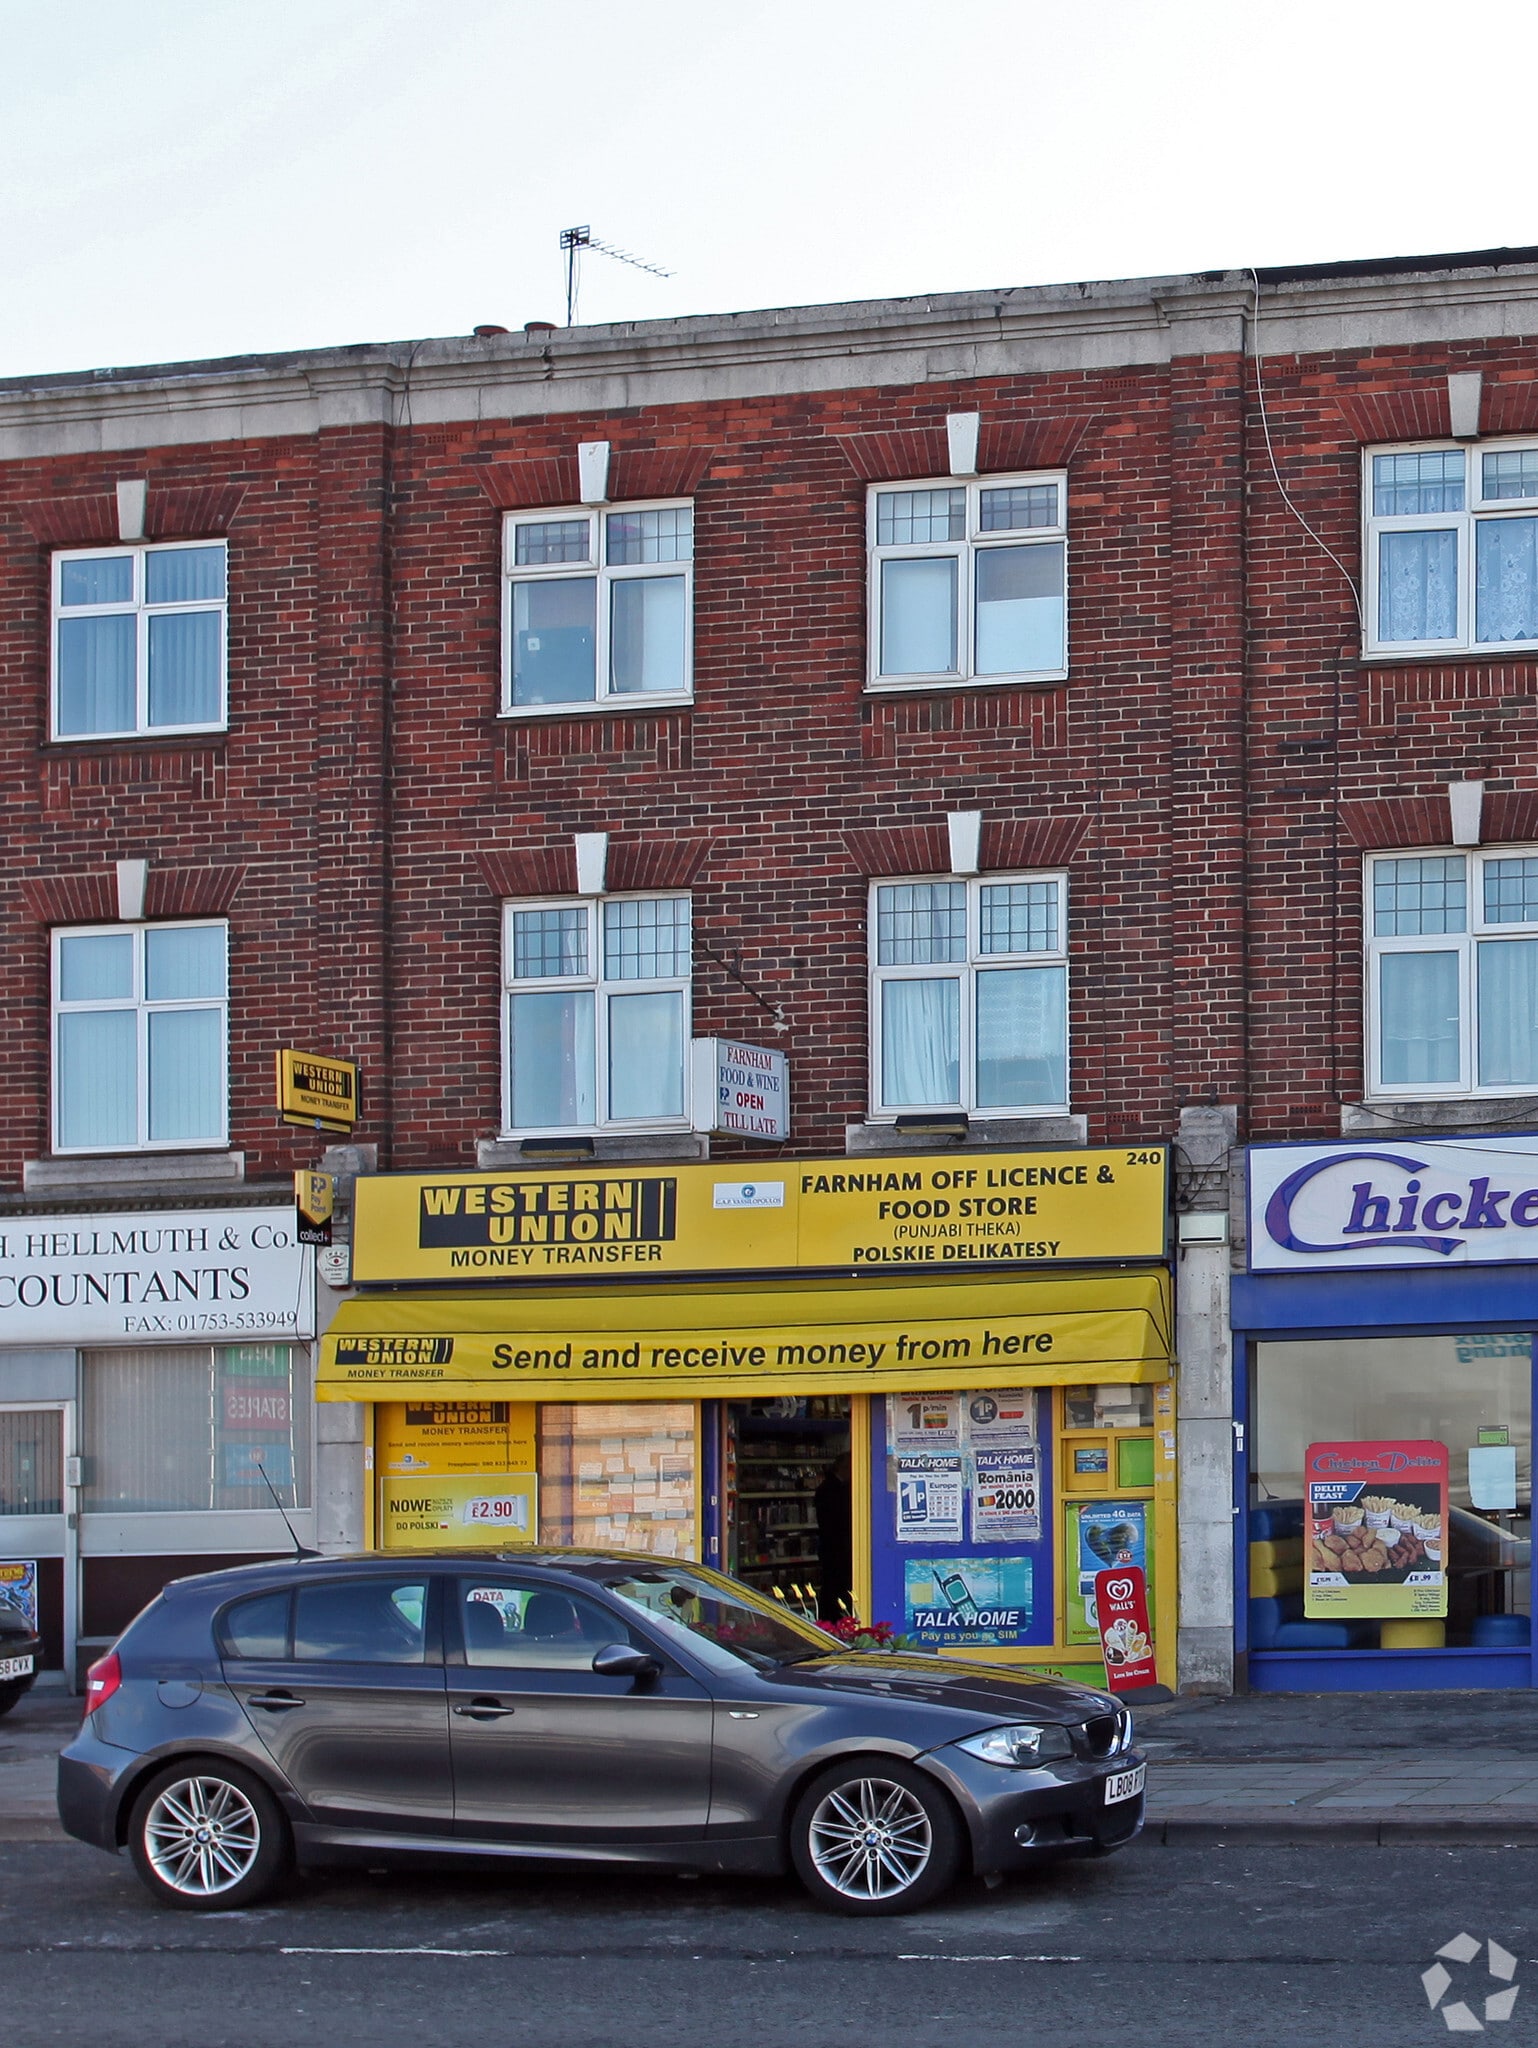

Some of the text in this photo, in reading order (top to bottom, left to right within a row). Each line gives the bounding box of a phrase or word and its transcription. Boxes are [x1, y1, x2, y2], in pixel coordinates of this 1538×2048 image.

[727, 1046, 772, 1071] FARNHAM
[293, 1062, 342, 1083] WESTERN
[720, 1066, 780, 1092] FOOD & WINE
[309, 1078, 342, 1096] UNION
[300, 1095, 350, 1111] MONEY TRANSFER
[736, 1092, 764, 1111] OPEN
[724, 1112, 777, 1135] TILL LATE
[1126, 1151, 1162, 1166] 240
[801, 1164, 1115, 1194] FARNHAM OFF LICENCE &
[311, 1194, 321, 1205] Pay
[423, 1182, 633, 1216] WESTERN
[311, 1203, 327, 1214] Point
[878, 1197, 1038, 1219] FOOD STORE
[488, 1212, 632, 1244] UNION
[894, 1222, 1021, 1241] (PUNJABI THEKA)
[26, 1229, 209, 1258] HELLMUTH
[218, 1226, 242, 1250] &
[251, 1224, 296, 1250] Co.
[451, 1244, 663, 1268] MONEY TRANSFER
[853, 1241, 1061, 1262] POLSKIE DELIKATESY
[124, 1311, 297, 1332] FAX: 01753-533949
[340, 1338, 435, 1352] WESTERN
[492, 1330, 1054, 1370] Send and receive money from here
[366, 1351, 433, 1364] UNION
[348, 1369, 444, 1378] MONEY TRANSFER
[407, 1401, 491, 1412] WESTERN
[434, 1411, 491, 1424] UNION
[422, 1426, 508, 1436] MONEY TRANSFER
[901, 1458, 959, 1468] TALK HOME
[977, 1454, 1033, 1466] TALK HOME
[1312, 1451, 1442, 1473] Chicken Delite
[978, 1471, 1033, 1484] România
[929, 1482, 958, 1490] Europe
[995, 1489, 1035, 1510] 2000
[1314, 1492, 1344, 1500] FEAST
[390, 1499, 431, 1513] NOWE
[1112, 1510, 1126, 1518] 4G
[396, 1521, 439, 1530] DO POLSKI
[473, 1592, 505, 1602] DATA
[1109, 1601, 1134, 1612] WALL'S
[914, 1610, 1019, 1627] TALK HOME
[921, 1630, 1018, 1642] Pay as you go SIM
[12, 1656, 30, 1673] CVX
